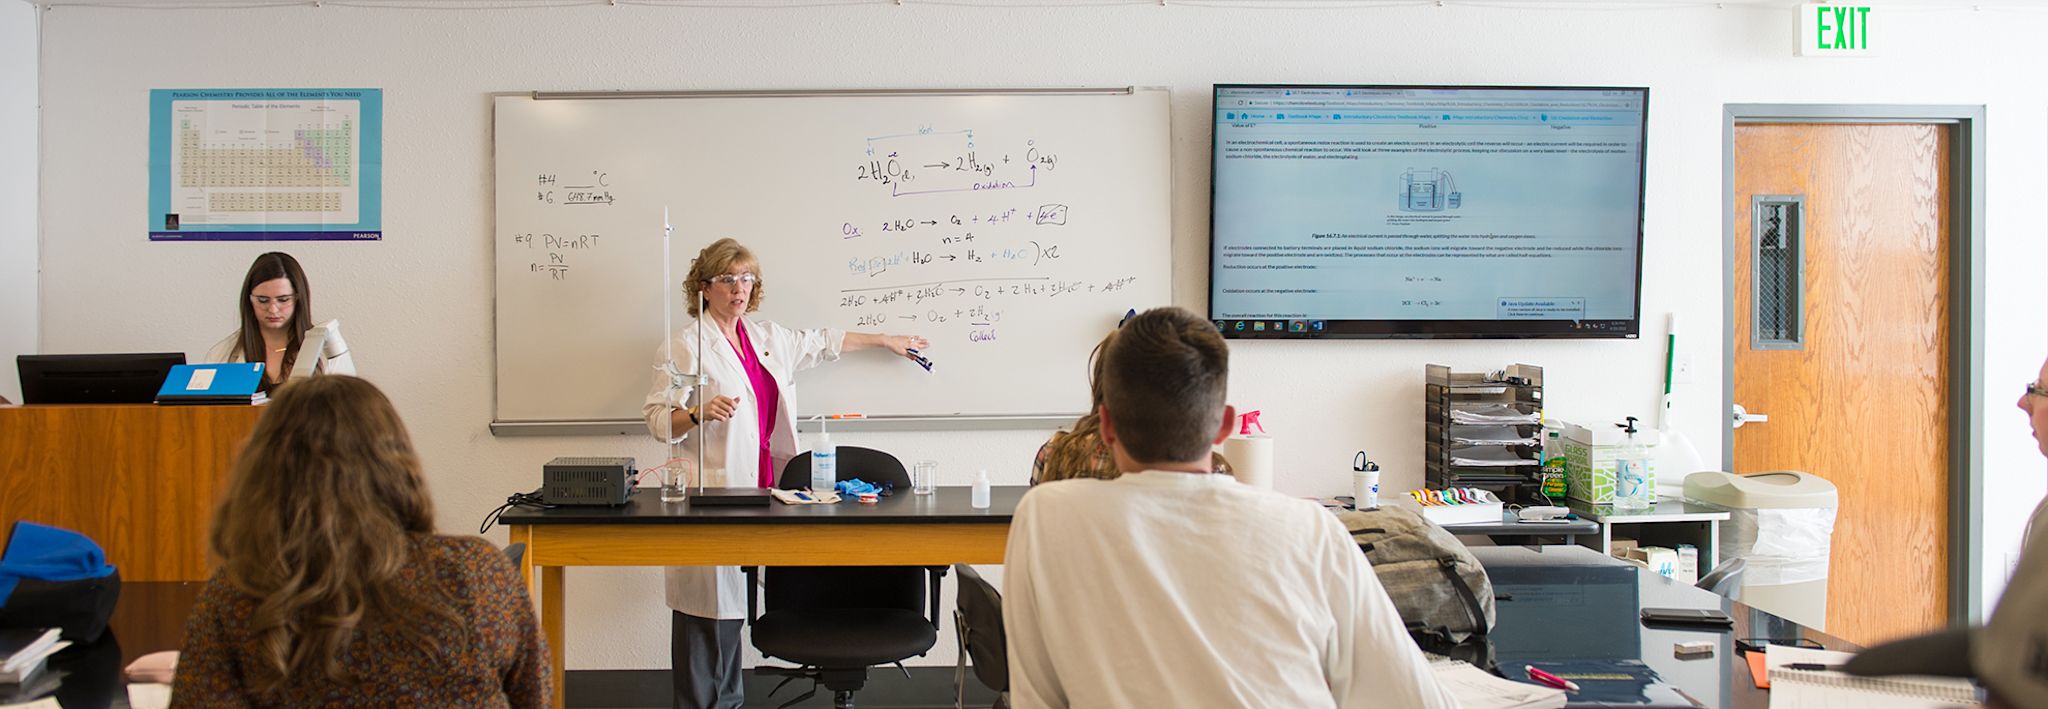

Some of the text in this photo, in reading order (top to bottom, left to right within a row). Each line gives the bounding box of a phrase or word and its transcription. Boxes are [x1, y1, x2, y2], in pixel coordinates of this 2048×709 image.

[1817, 6, 1870, 49] EXIT
[515, 233, 532, 248] #9
[549, 268, 568, 280] RT
